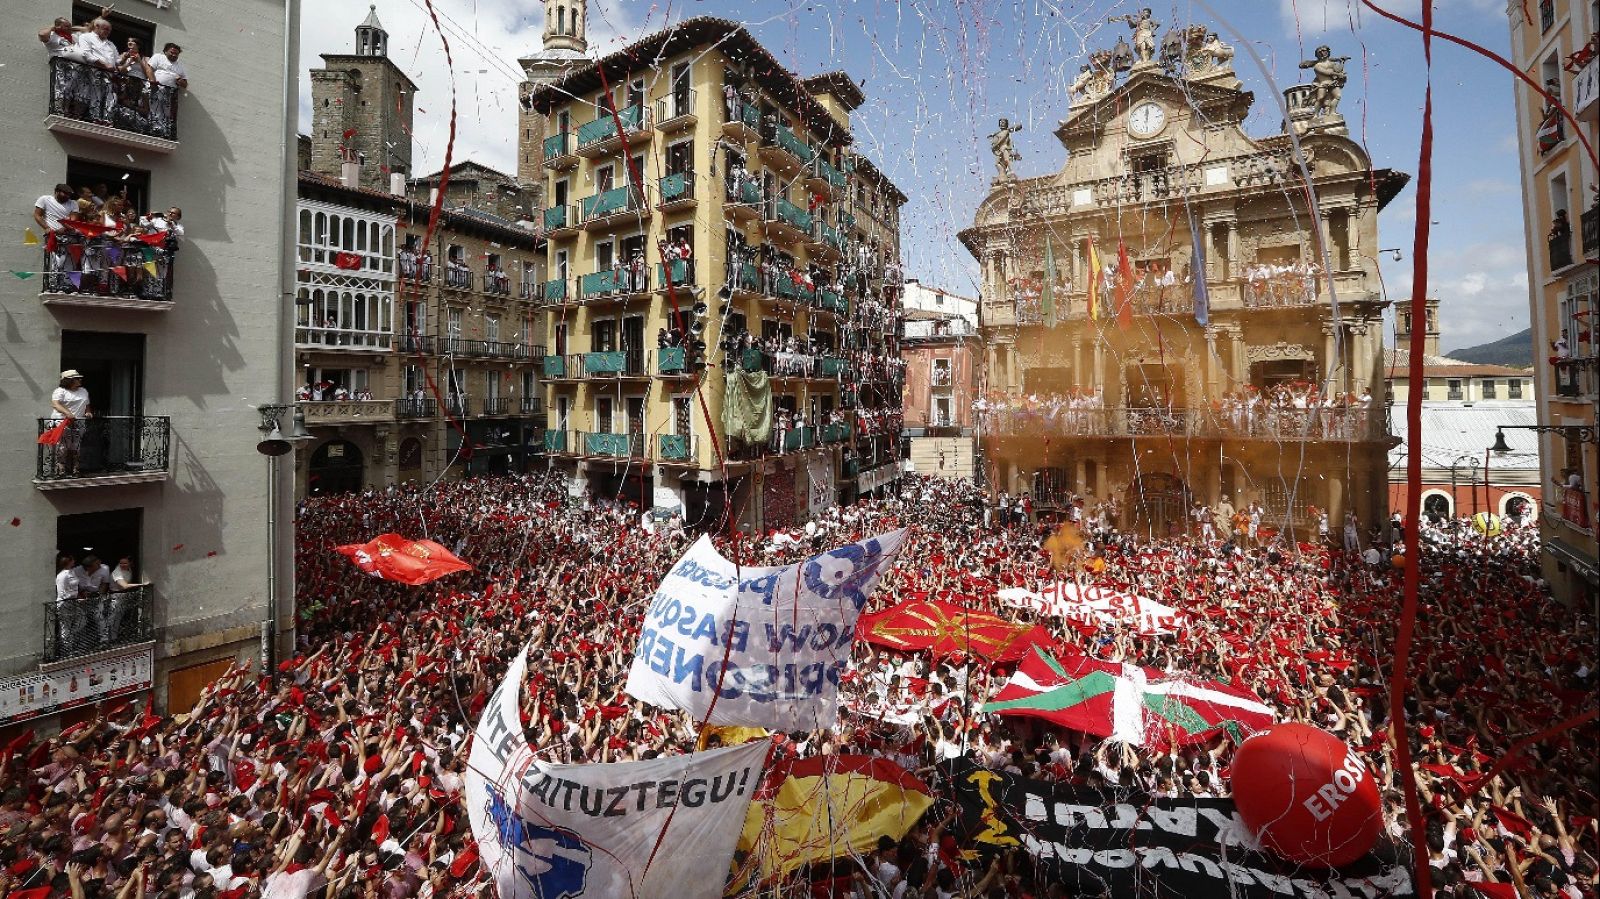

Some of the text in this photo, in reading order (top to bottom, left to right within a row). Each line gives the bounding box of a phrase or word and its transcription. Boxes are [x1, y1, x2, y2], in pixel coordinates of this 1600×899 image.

[485, 676, 751, 818] AITE ZAITUZTEGU!
[1303, 745, 1366, 822] EROSK
